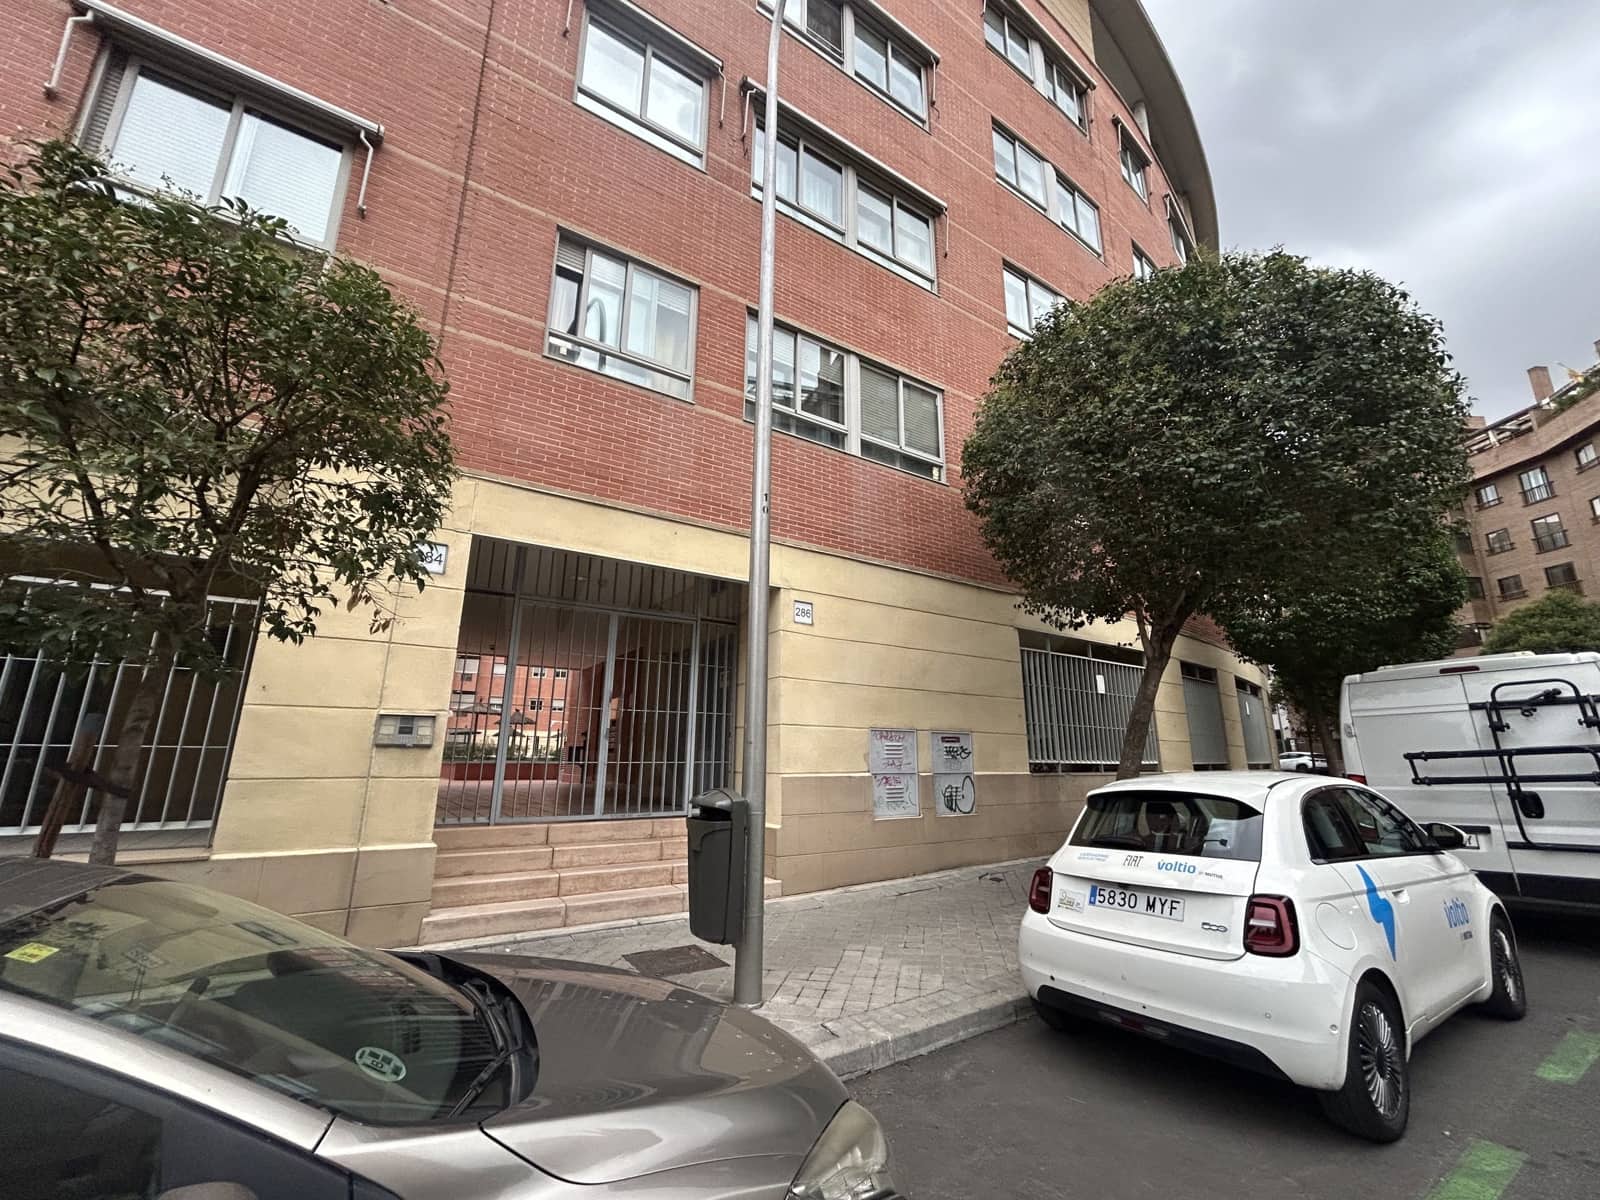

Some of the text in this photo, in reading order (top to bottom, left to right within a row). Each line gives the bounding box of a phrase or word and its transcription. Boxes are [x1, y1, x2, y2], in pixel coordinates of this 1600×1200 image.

[795, 607, 811, 619] 286
[1122, 854, 1144, 868] FIAT
[1157, 859, 1197, 875] voltio
[1097, 887, 1138, 909] 5830
[1145, 895, 1181, 917] MYF
